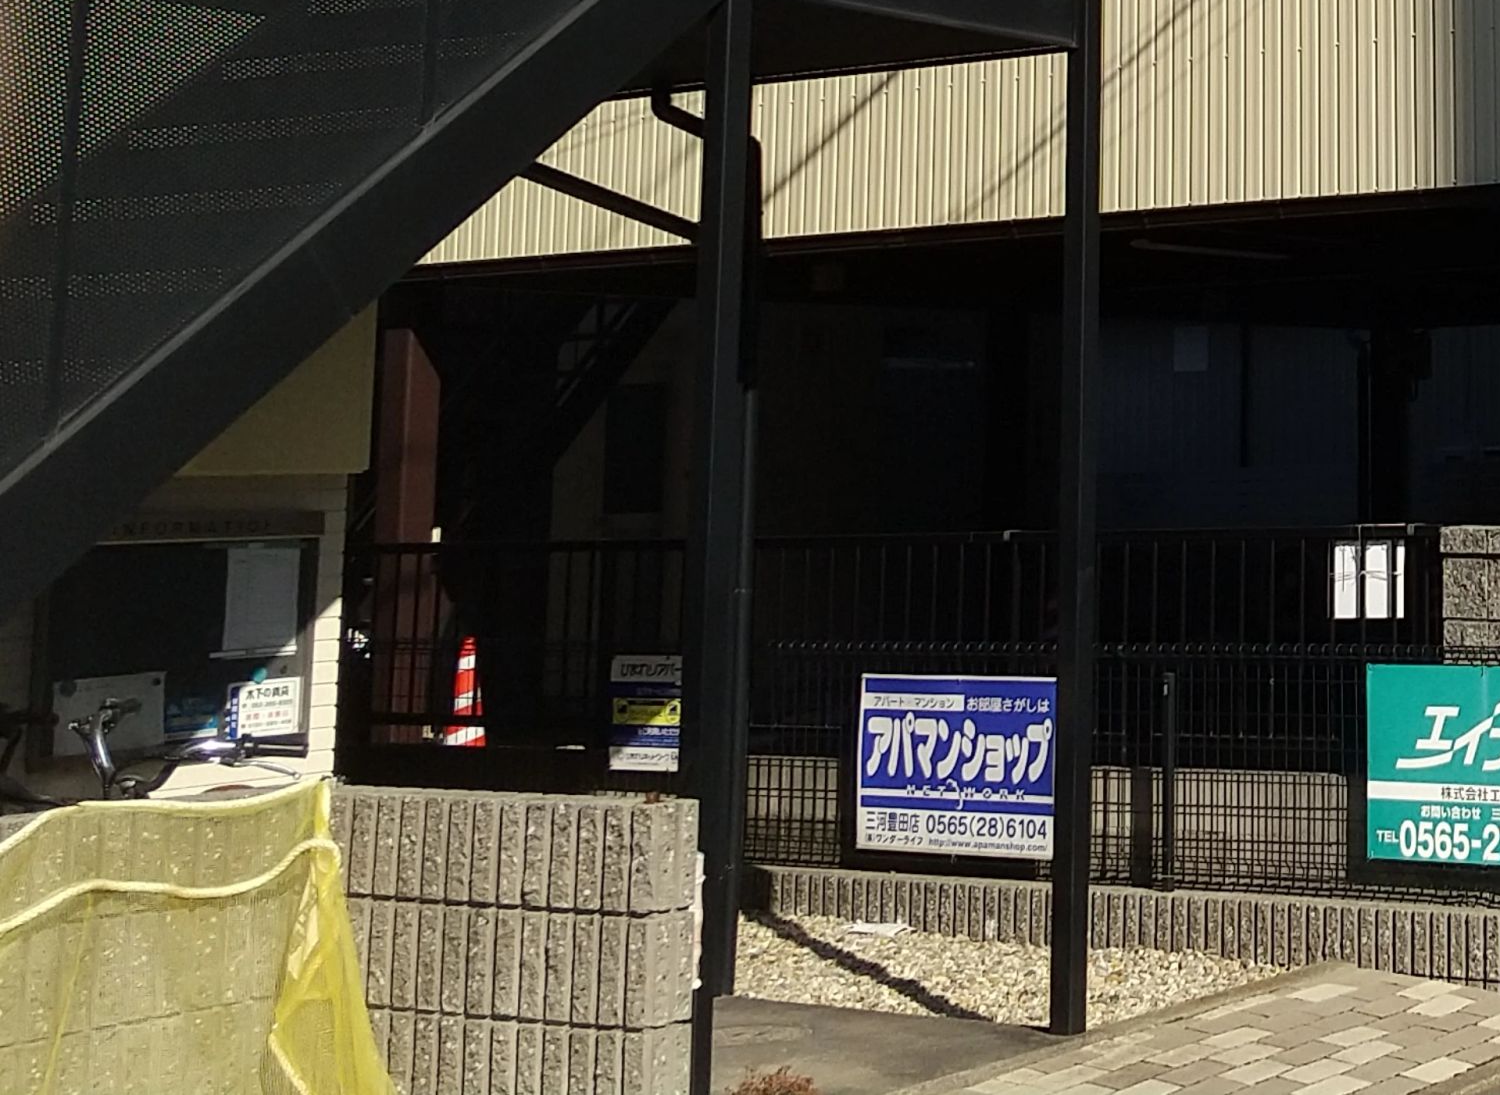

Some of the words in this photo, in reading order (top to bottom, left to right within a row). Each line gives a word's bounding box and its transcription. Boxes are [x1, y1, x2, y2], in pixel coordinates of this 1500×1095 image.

[966, 697, 1050, 713] お部屋さがしは
[866, 711, 1053, 785] アパマンショップ
[1420, 805, 1481, 820] お問い合わせ
[865, 811, 920, 833] 三河豊田店
[926, 814, 1047, 840] 0565(28)6104
[1376, 830, 1398, 844] TEL
